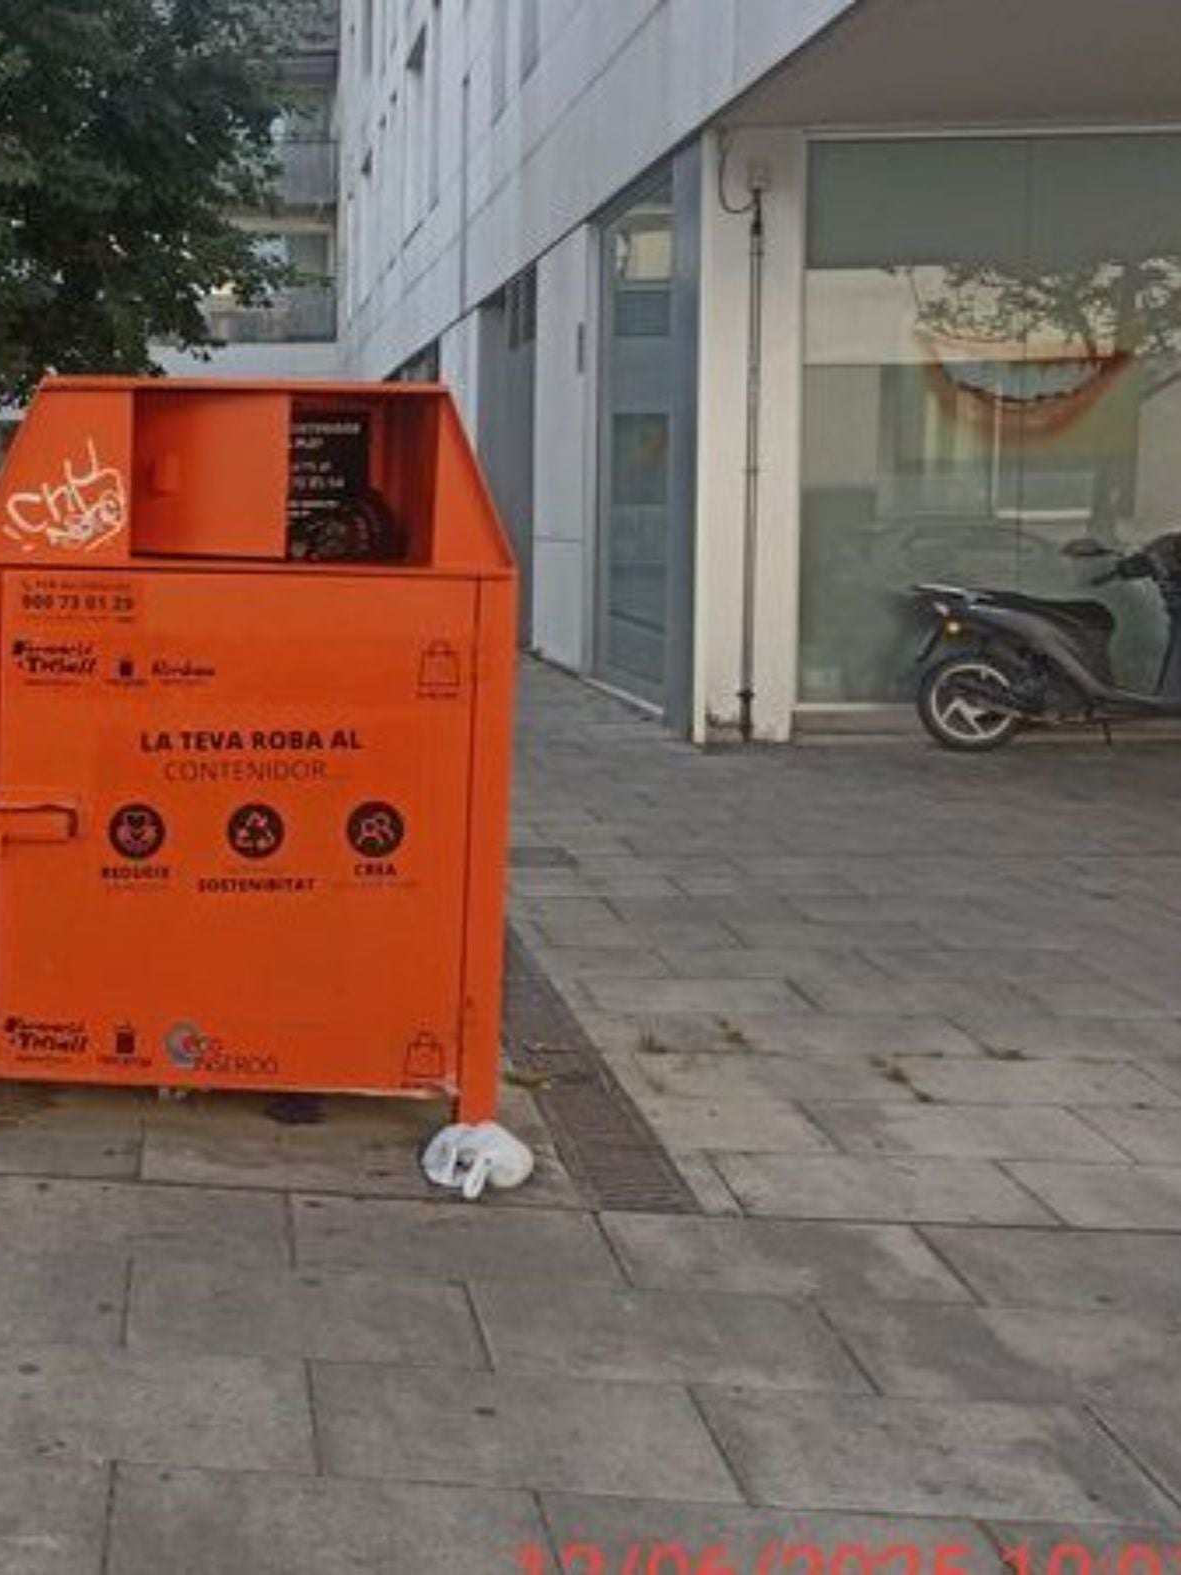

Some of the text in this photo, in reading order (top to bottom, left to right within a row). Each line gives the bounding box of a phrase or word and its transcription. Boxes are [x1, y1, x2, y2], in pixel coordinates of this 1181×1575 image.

[140, 730, 364, 751] LA TEVA ROBA AL
